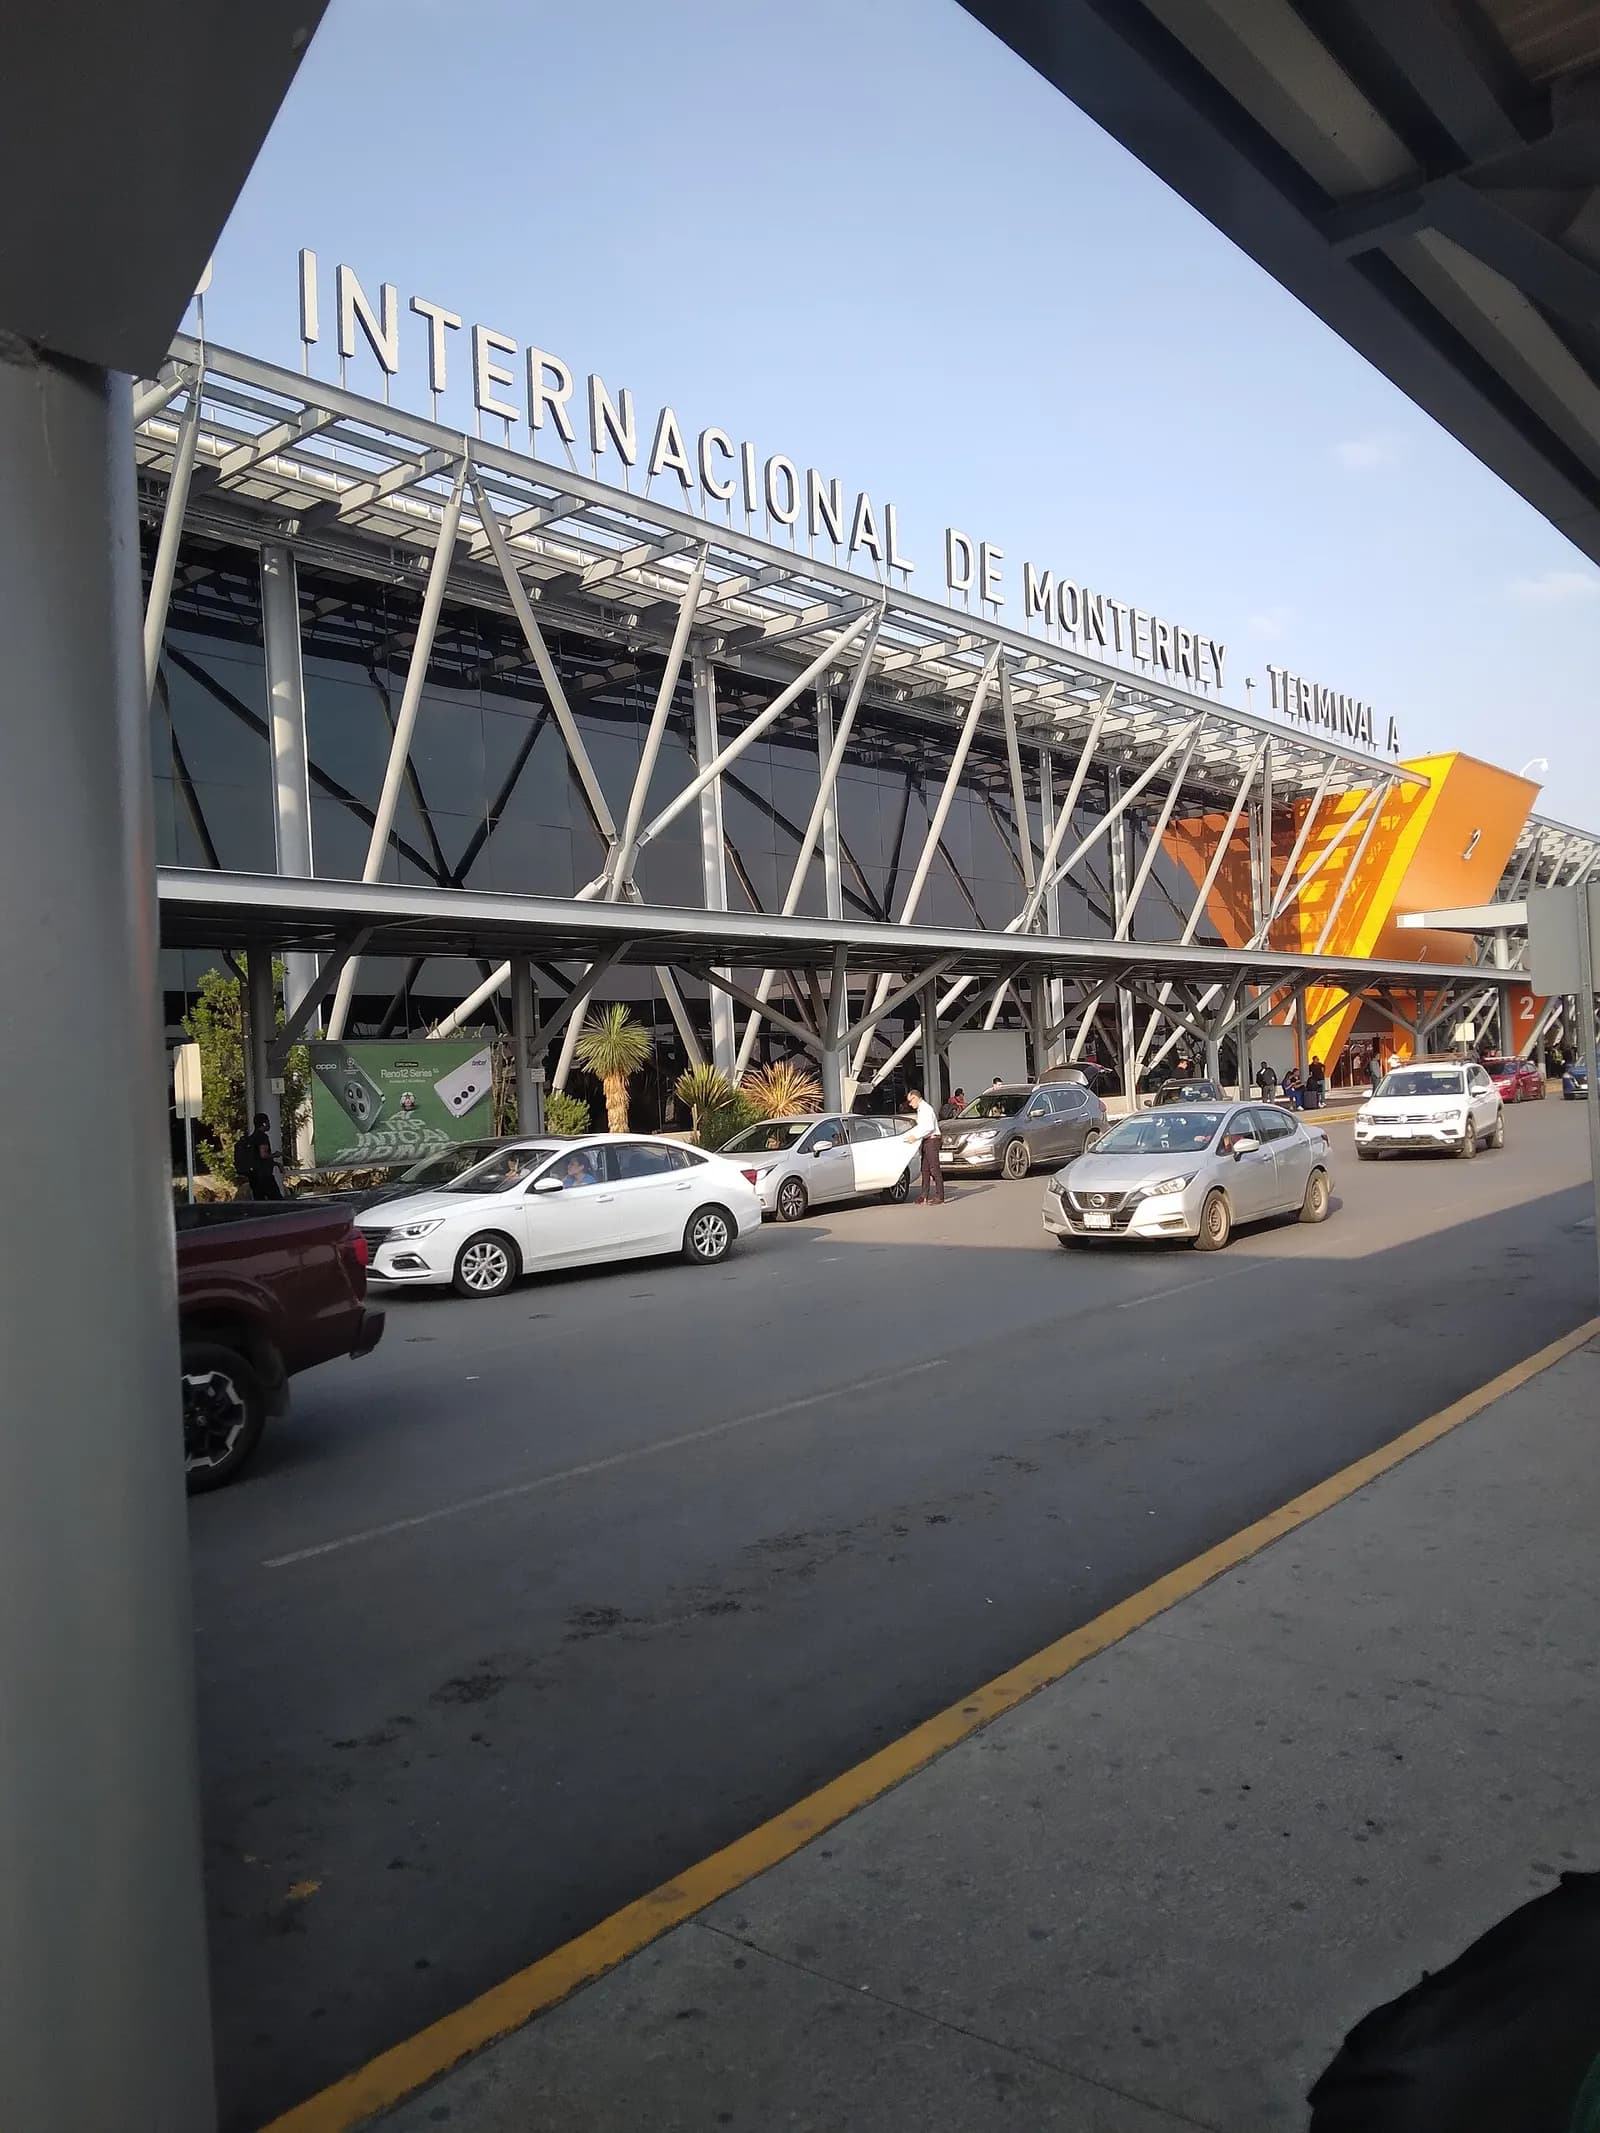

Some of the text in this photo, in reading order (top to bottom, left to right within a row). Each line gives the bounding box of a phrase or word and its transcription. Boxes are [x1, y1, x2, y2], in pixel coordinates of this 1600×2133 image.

[298, 247, 915, 573] INTERNACIONAL
[946, 526, 1006, 606] DE
[1023, 561, 1228, 689] MONTERREY
[1266, 664, 1380, 747] TERMINAL
[1387, 715, 1401, 754] A
[1519, 995, 1535, 1020] 2
[380, 1069, 408, 1079] Reno12
[409, 1069, 433, 1078] Series
